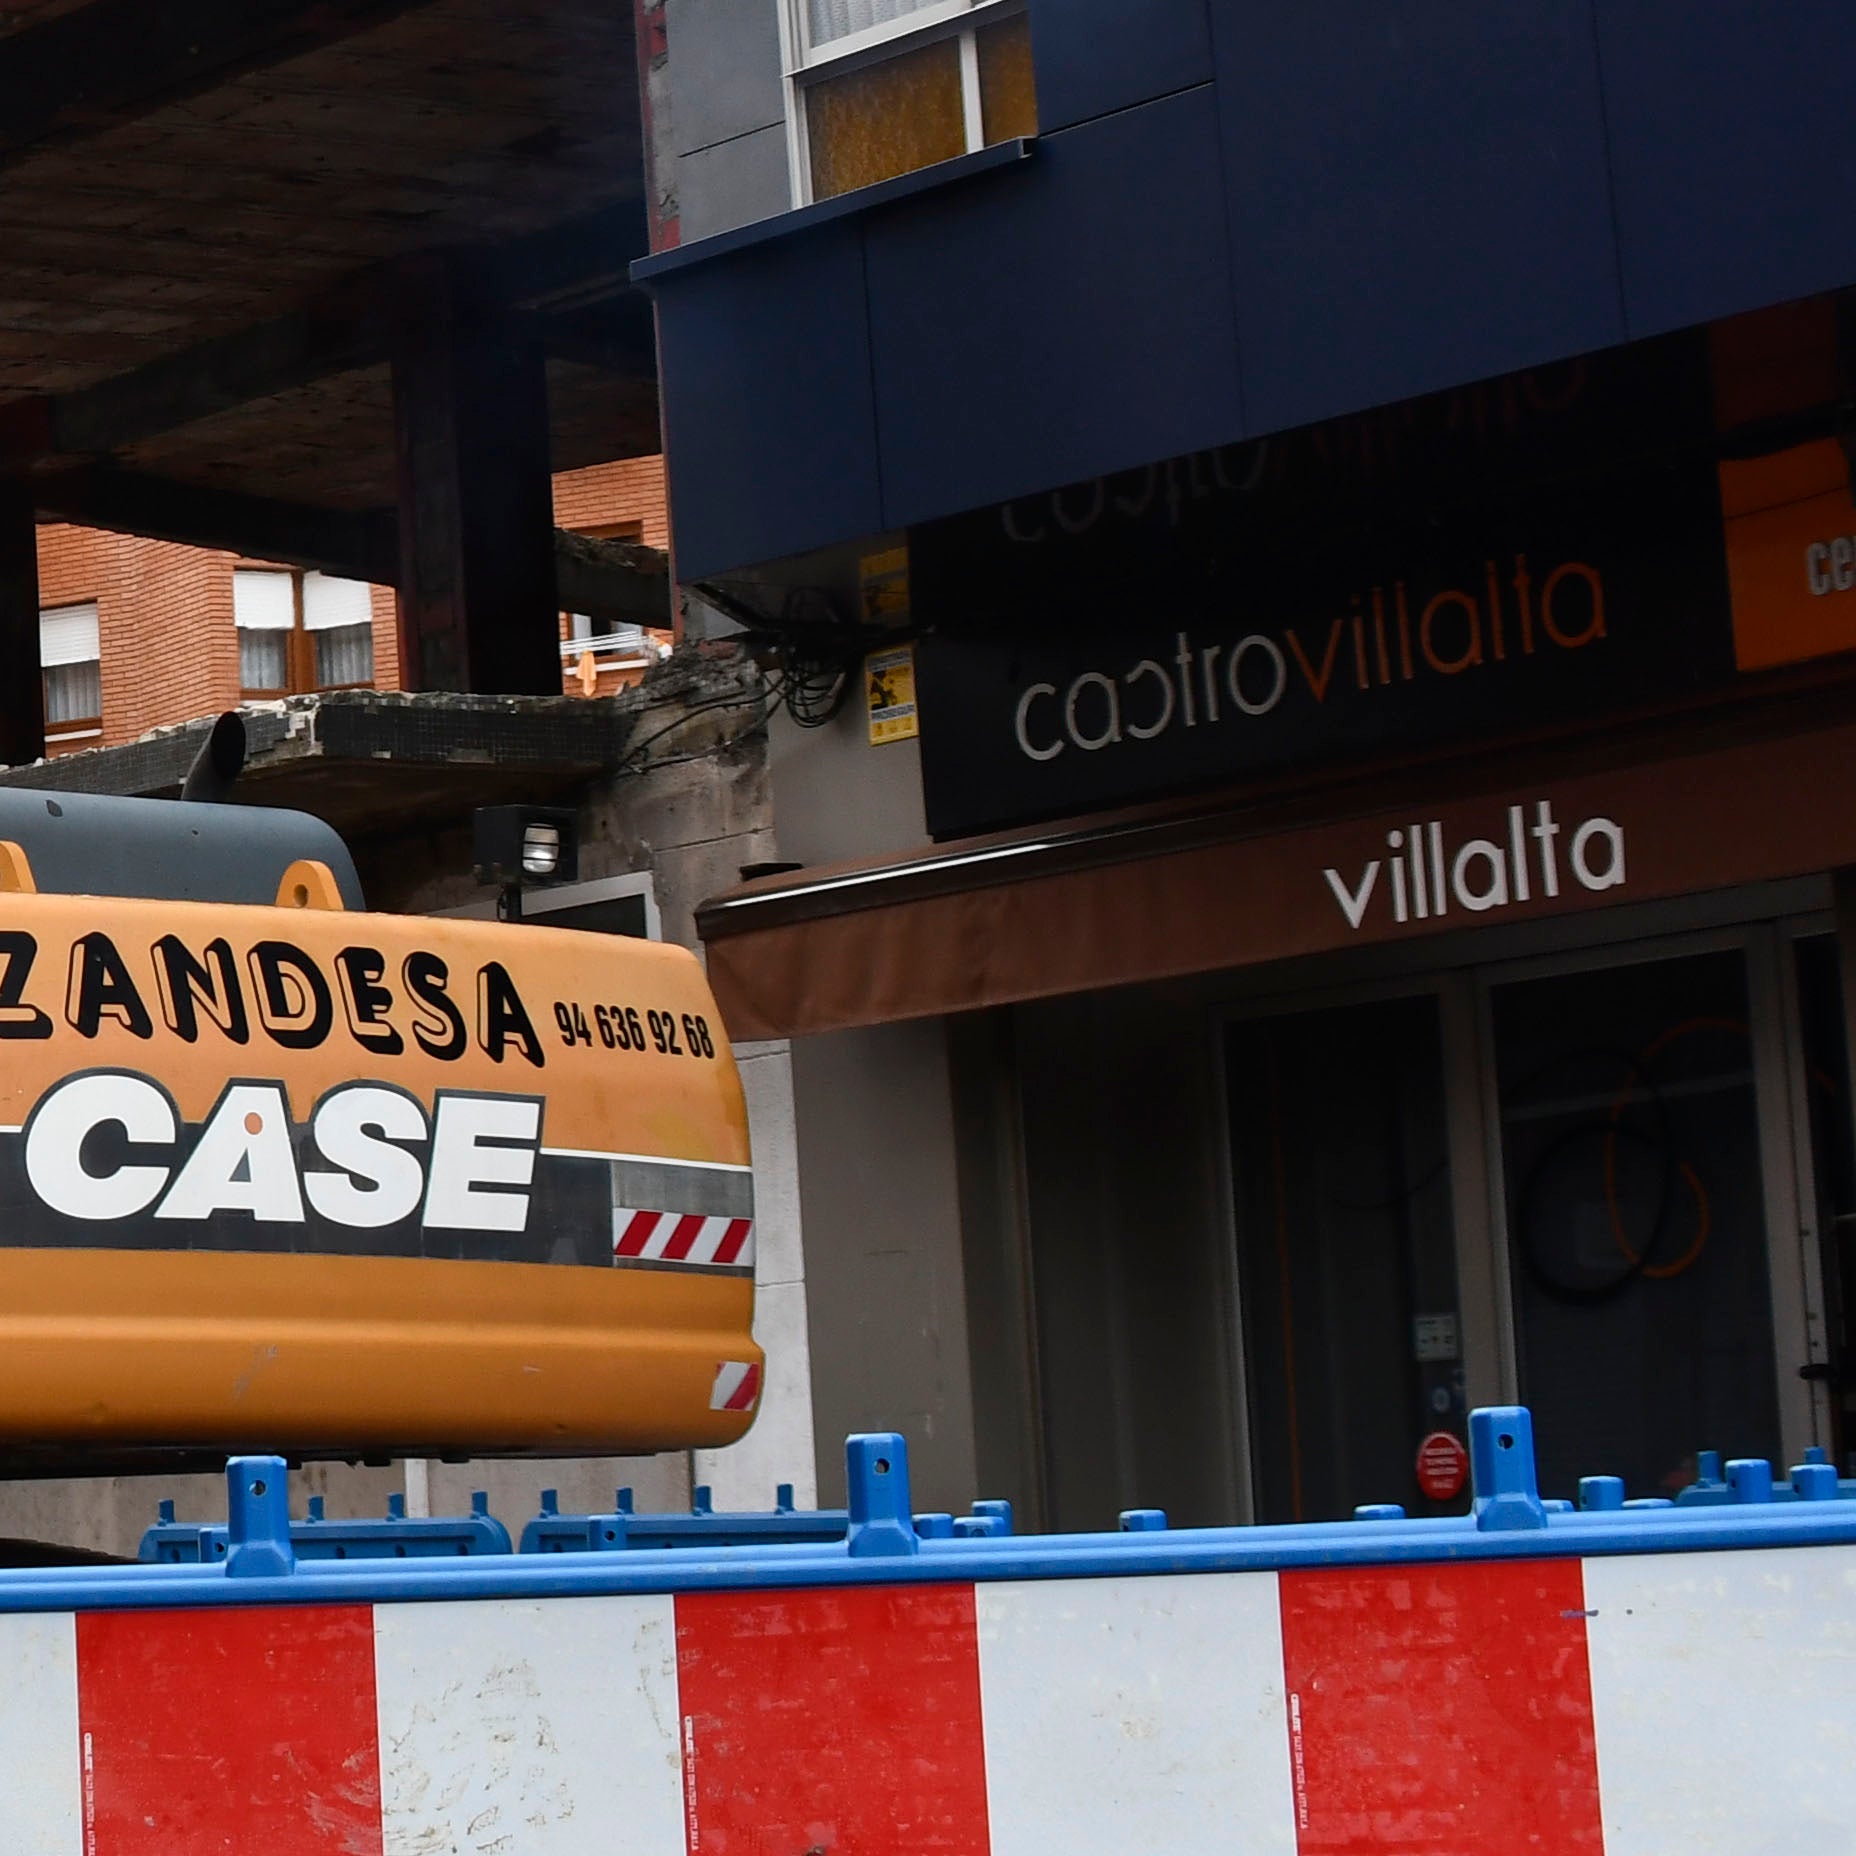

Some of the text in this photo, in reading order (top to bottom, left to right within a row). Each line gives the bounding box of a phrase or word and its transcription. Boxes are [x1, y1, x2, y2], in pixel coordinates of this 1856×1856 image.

[1806, 535, 1856, 596] ce
[1324, 800, 1626, 929] villalta
[553, 1001, 715, 1059] 94 636 92 68
[24, 1073, 543, 1232] CASE
